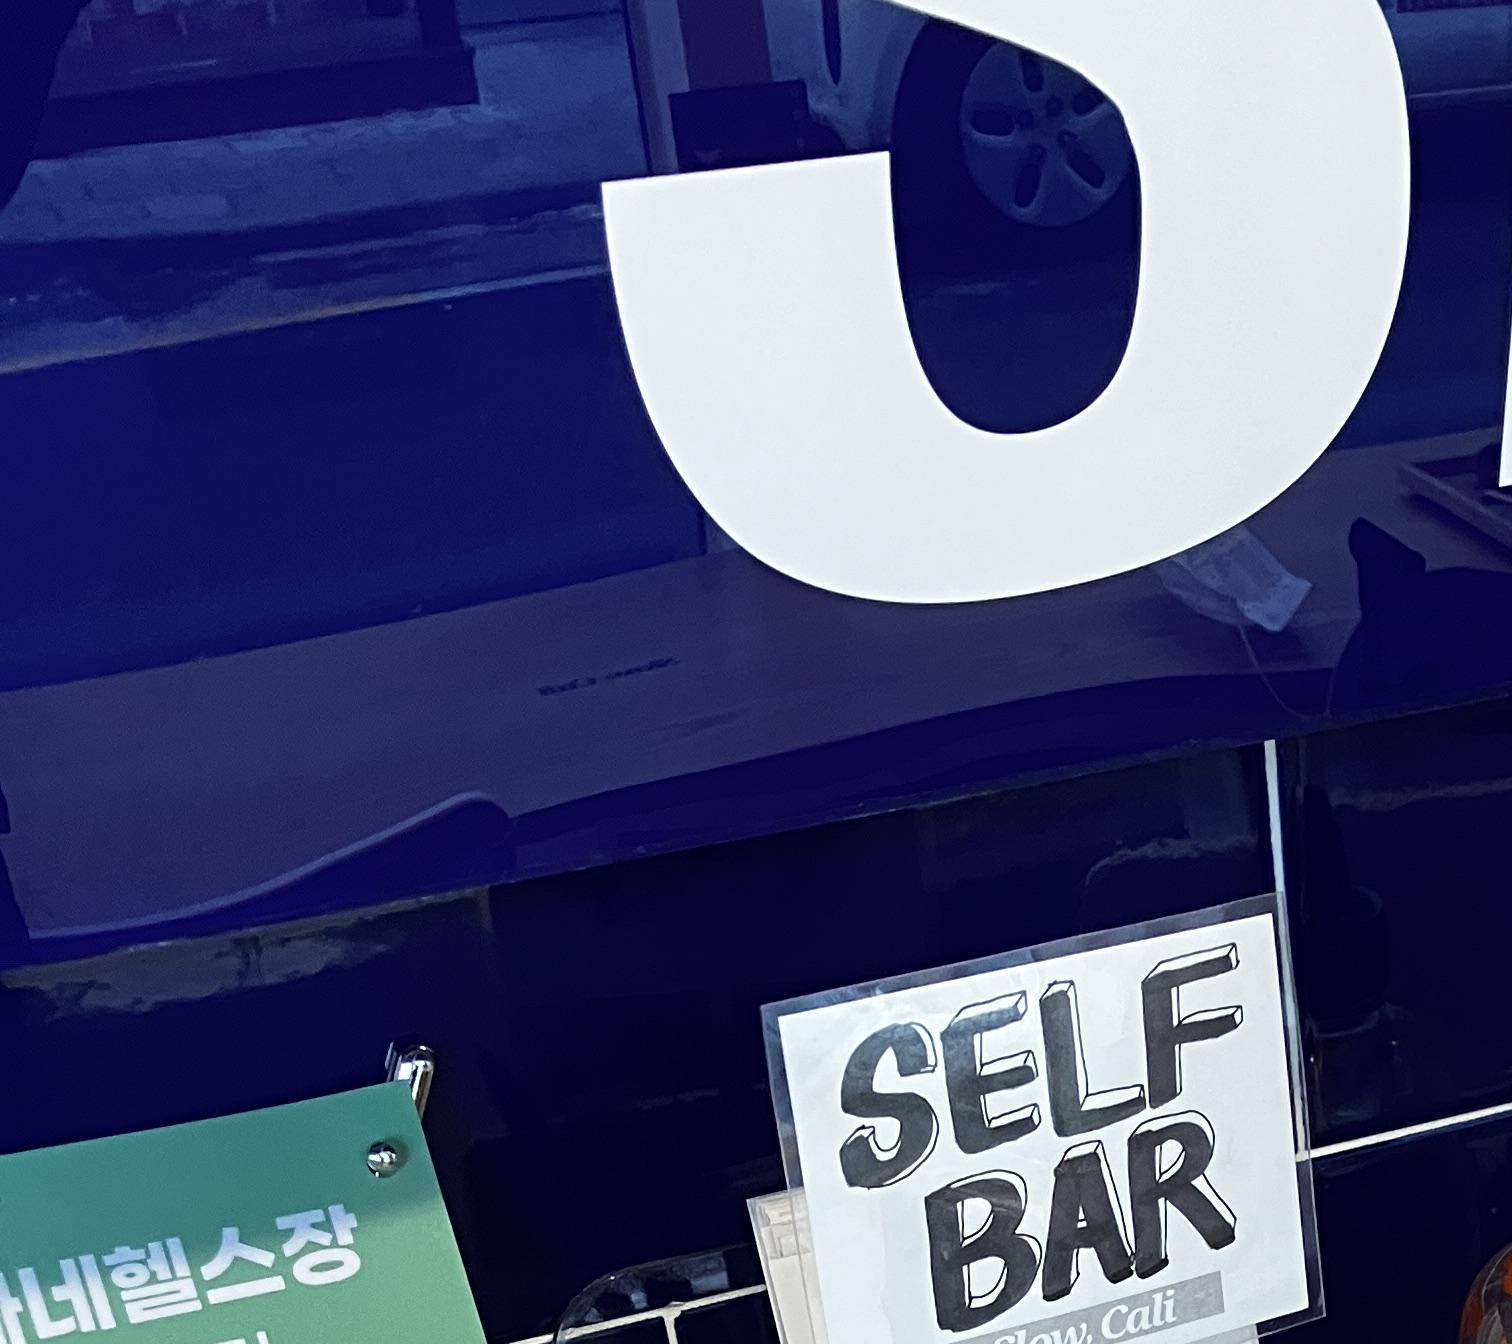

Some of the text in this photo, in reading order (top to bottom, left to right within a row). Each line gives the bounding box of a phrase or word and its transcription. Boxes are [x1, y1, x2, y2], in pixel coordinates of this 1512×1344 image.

[839, 942, 1244, 1191] SELF
[924, 1110, 1237, 1332] BAR
[1101, 1289, 1178, 1341] Cali
